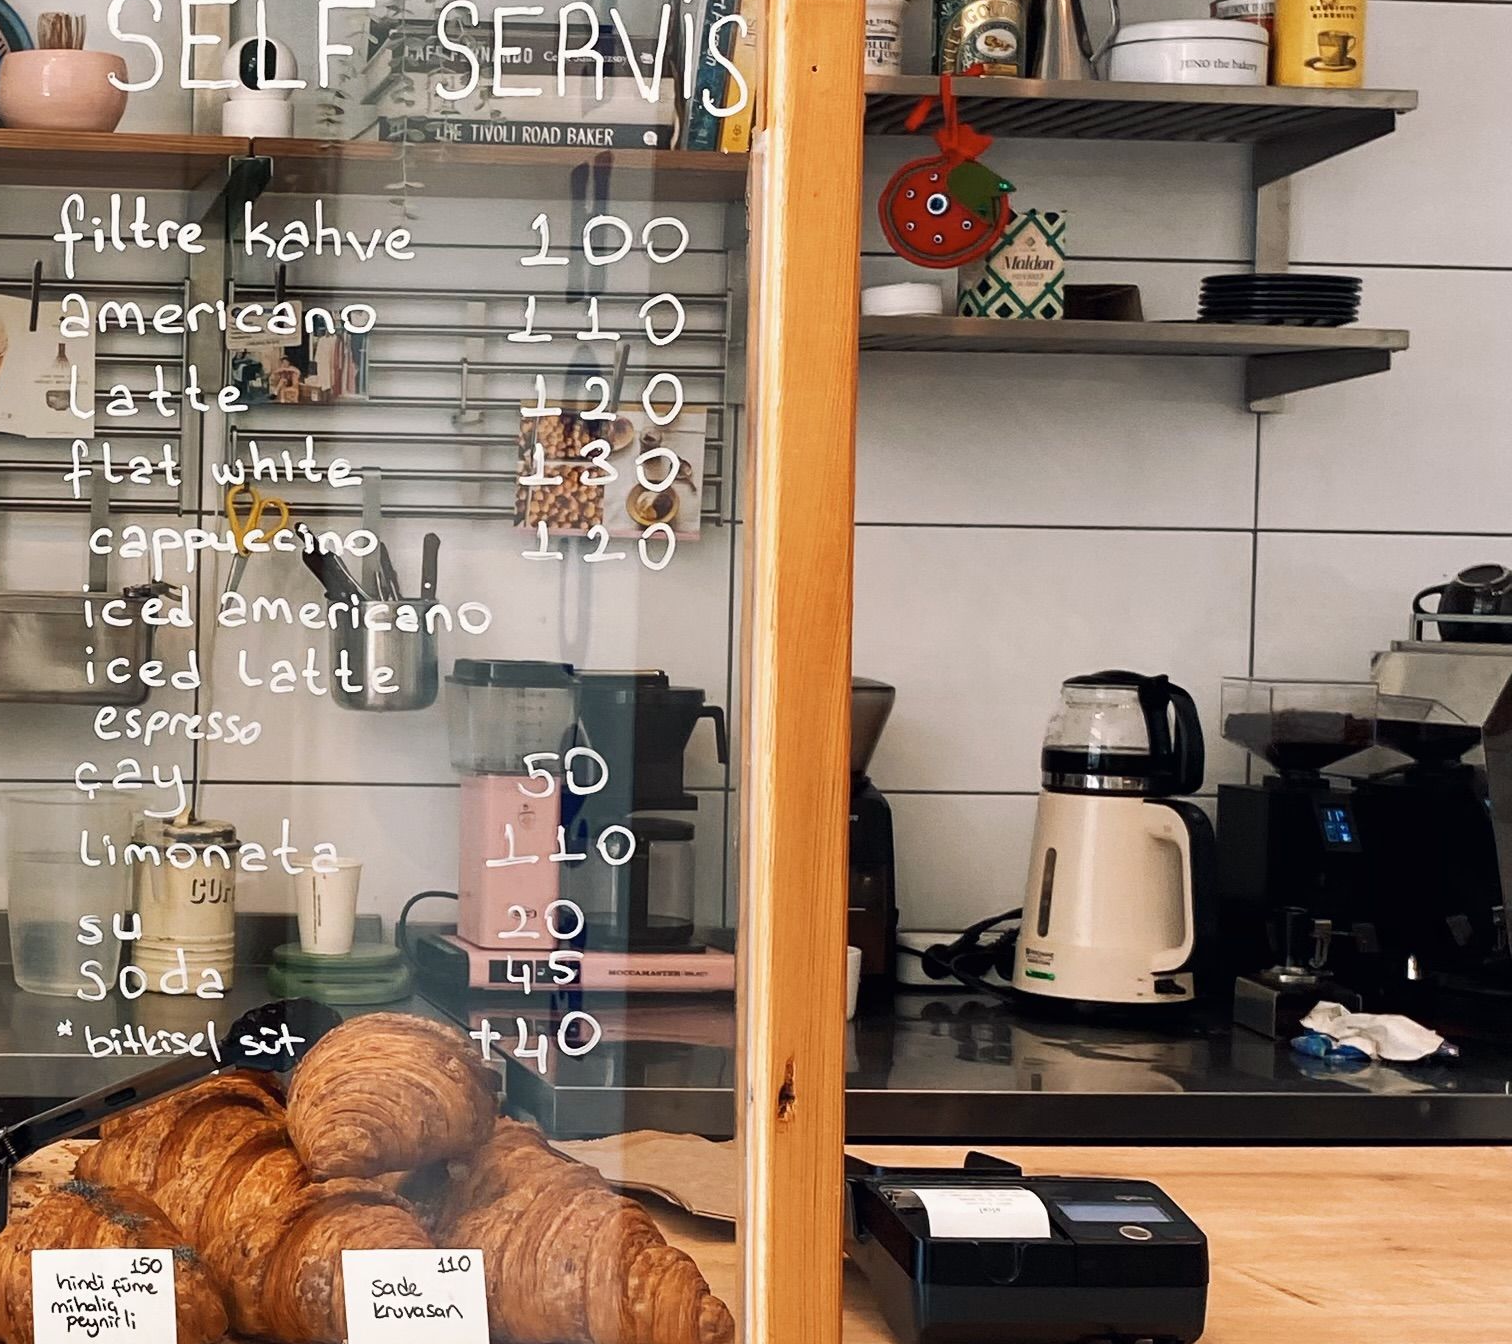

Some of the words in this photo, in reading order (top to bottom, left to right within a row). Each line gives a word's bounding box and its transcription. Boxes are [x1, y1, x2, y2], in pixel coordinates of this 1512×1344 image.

[1214, 58, 1230, 69] the
[471, 124, 516, 143] TIVOLI
[522, 126, 561, 145] ROAD
[567, 128, 614, 147] BAKER
[53, 193, 205, 278] filtre
[244, 197, 416, 262] kahve
[520, 212, 690, 267] 100
[1004, 255, 1055, 270] Maldon
[59, 292, 378, 340] americano
[507, 295, 686, 346] 110
[69, 365, 249, 420] latte
[519, 373, 685, 427] 120
[63, 438, 182, 499] flat
[211, 434, 364, 489] white
[518, 442, 682, 493] 130
[89, 521, 379, 580] cappuccino
[521, 520, 677, 571] 120
[83, 583, 194, 629] iced
[218, 594, 493, 636] americano
[84, 645, 201, 692] iced
[238, 648, 400, 695] latte
[92, 705, 262, 748] espresso
[74, 756, 190, 819] çay
[516, 746, 610, 801] 50
[80, 818, 339, 875] limonata
[485, 822, 637, 870] 110
[78, 908, 142, 946] su
[497, 898, 586, 940] 20
[506, 950, 585, 994] 45
[470, 1010, 602, 1074] +40
[55, 1272, 105, 1291] hindi
[130, 1256, 163, 1274] 150
[437, 1255, 472, 1274] 110
[66, 1309, 136, 1338] peynirli
[373, 1302, 464, 1319] kruvasan
